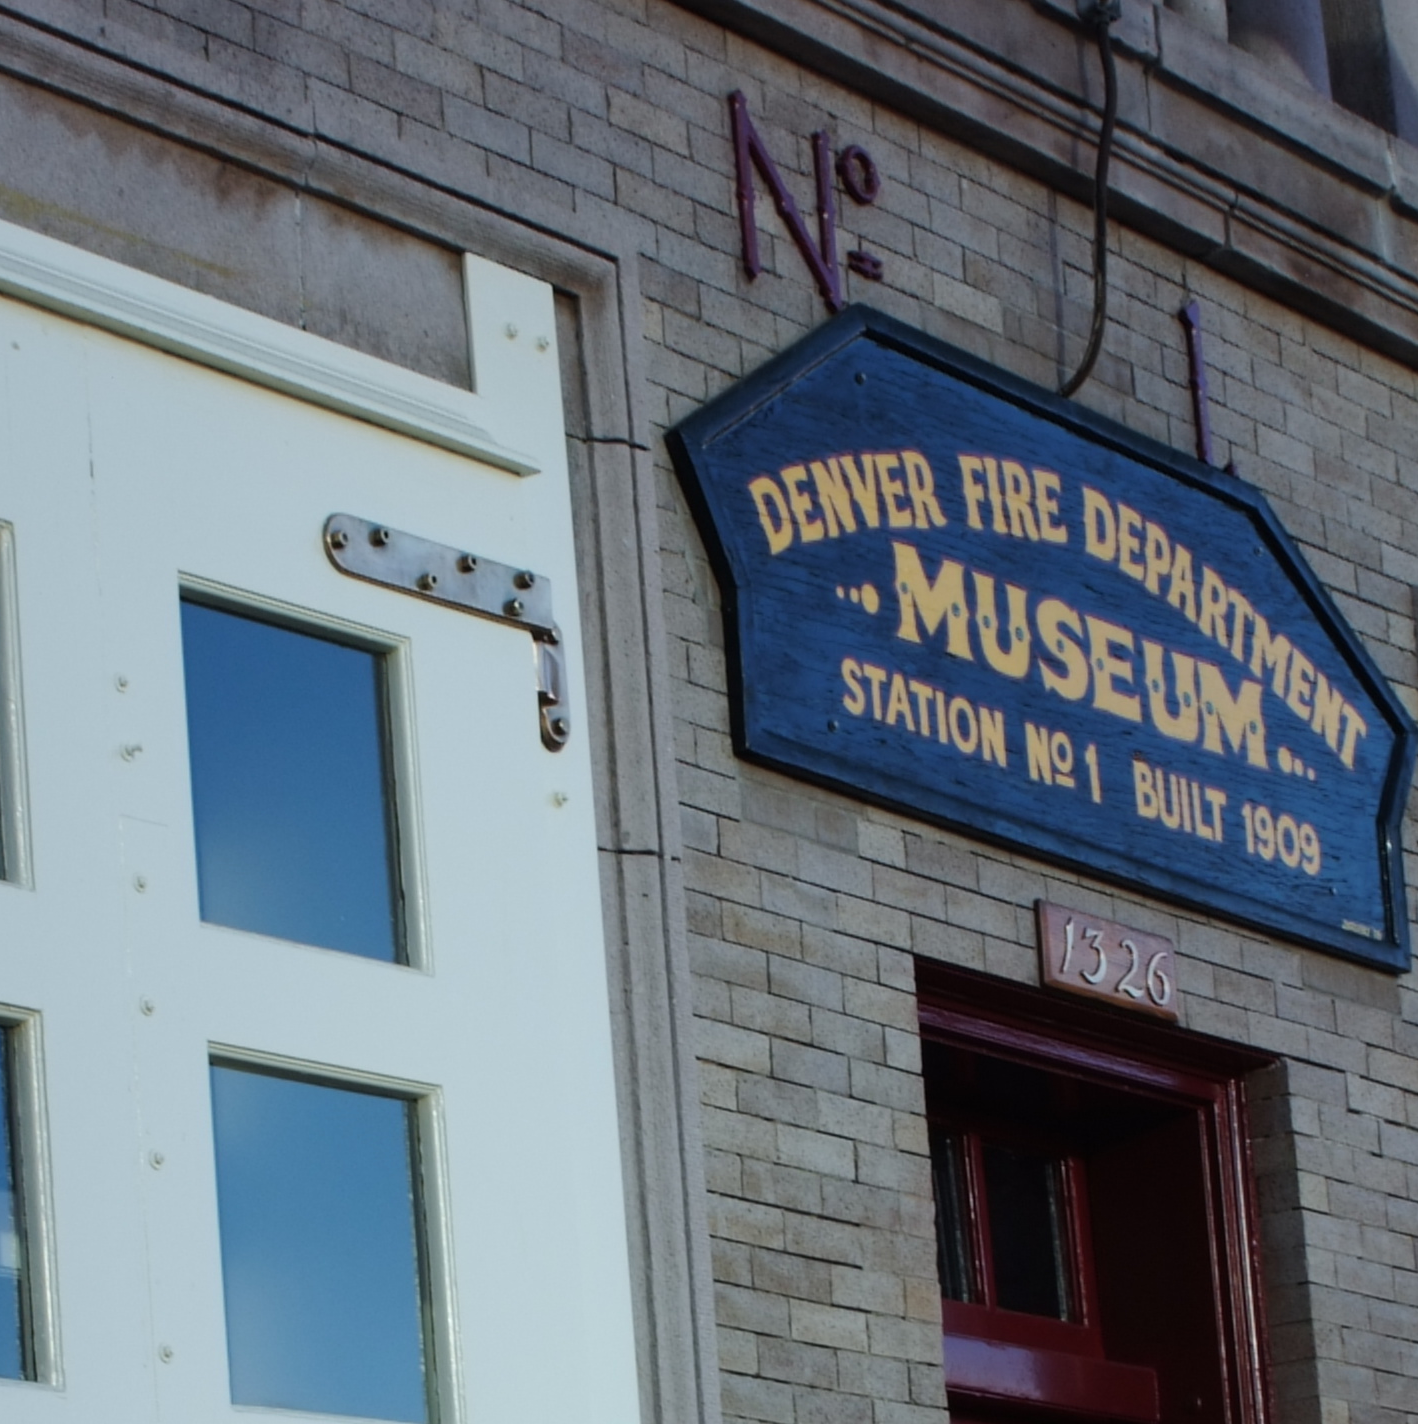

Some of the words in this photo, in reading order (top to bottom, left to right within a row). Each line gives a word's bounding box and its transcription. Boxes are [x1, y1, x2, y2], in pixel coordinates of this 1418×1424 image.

[748, 449, 947, 554] DENVER
[959, 454, 1068, 543] FIRE
[1084, 487, 1366, 770] DEPARTMENT
[893, 541, 1268, 772] MUSEUM
[842, 658, 1007, 769] STATION
[1133, 759, 1227, 840] BUILT
[1244, 806, 1322, 875] 1909
[1061, 917, 1171, 1006] 1326
